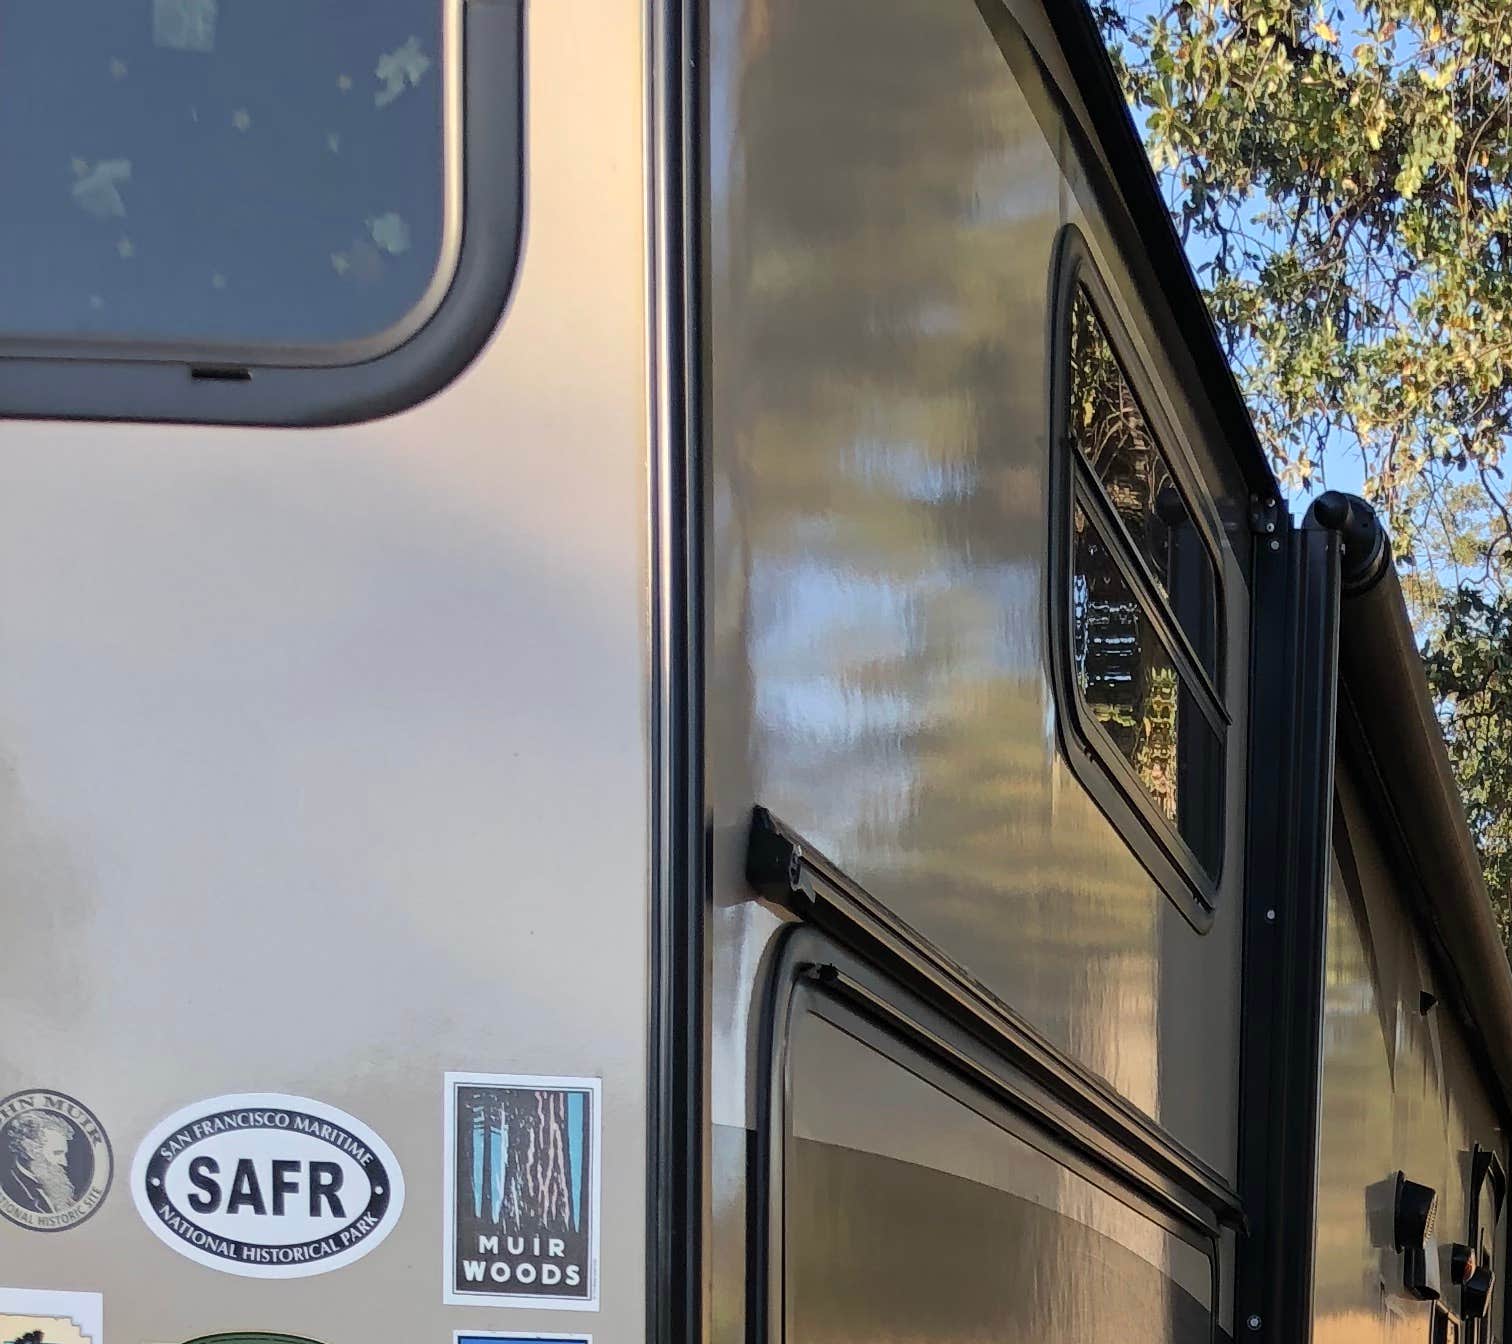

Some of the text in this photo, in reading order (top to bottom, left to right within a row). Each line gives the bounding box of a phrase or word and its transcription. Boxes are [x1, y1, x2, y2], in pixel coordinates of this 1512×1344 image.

[43, 1096, 102, 1146] MUIR
[160, 1112, 374, 1167] SAN FRANCISCO MARITIME
[38, 1205, 85, 1226] HISTORIC
[85, 1187, 102, 1209] SITE
[187, 1155, 346, 1218] SAFR
[159, 1203, 379, 1263] NATIONAL HISTORICAL PARK
[478, 1234, 565, 1257] MUIR
[463, 1260, 581, 1286] WOODS
